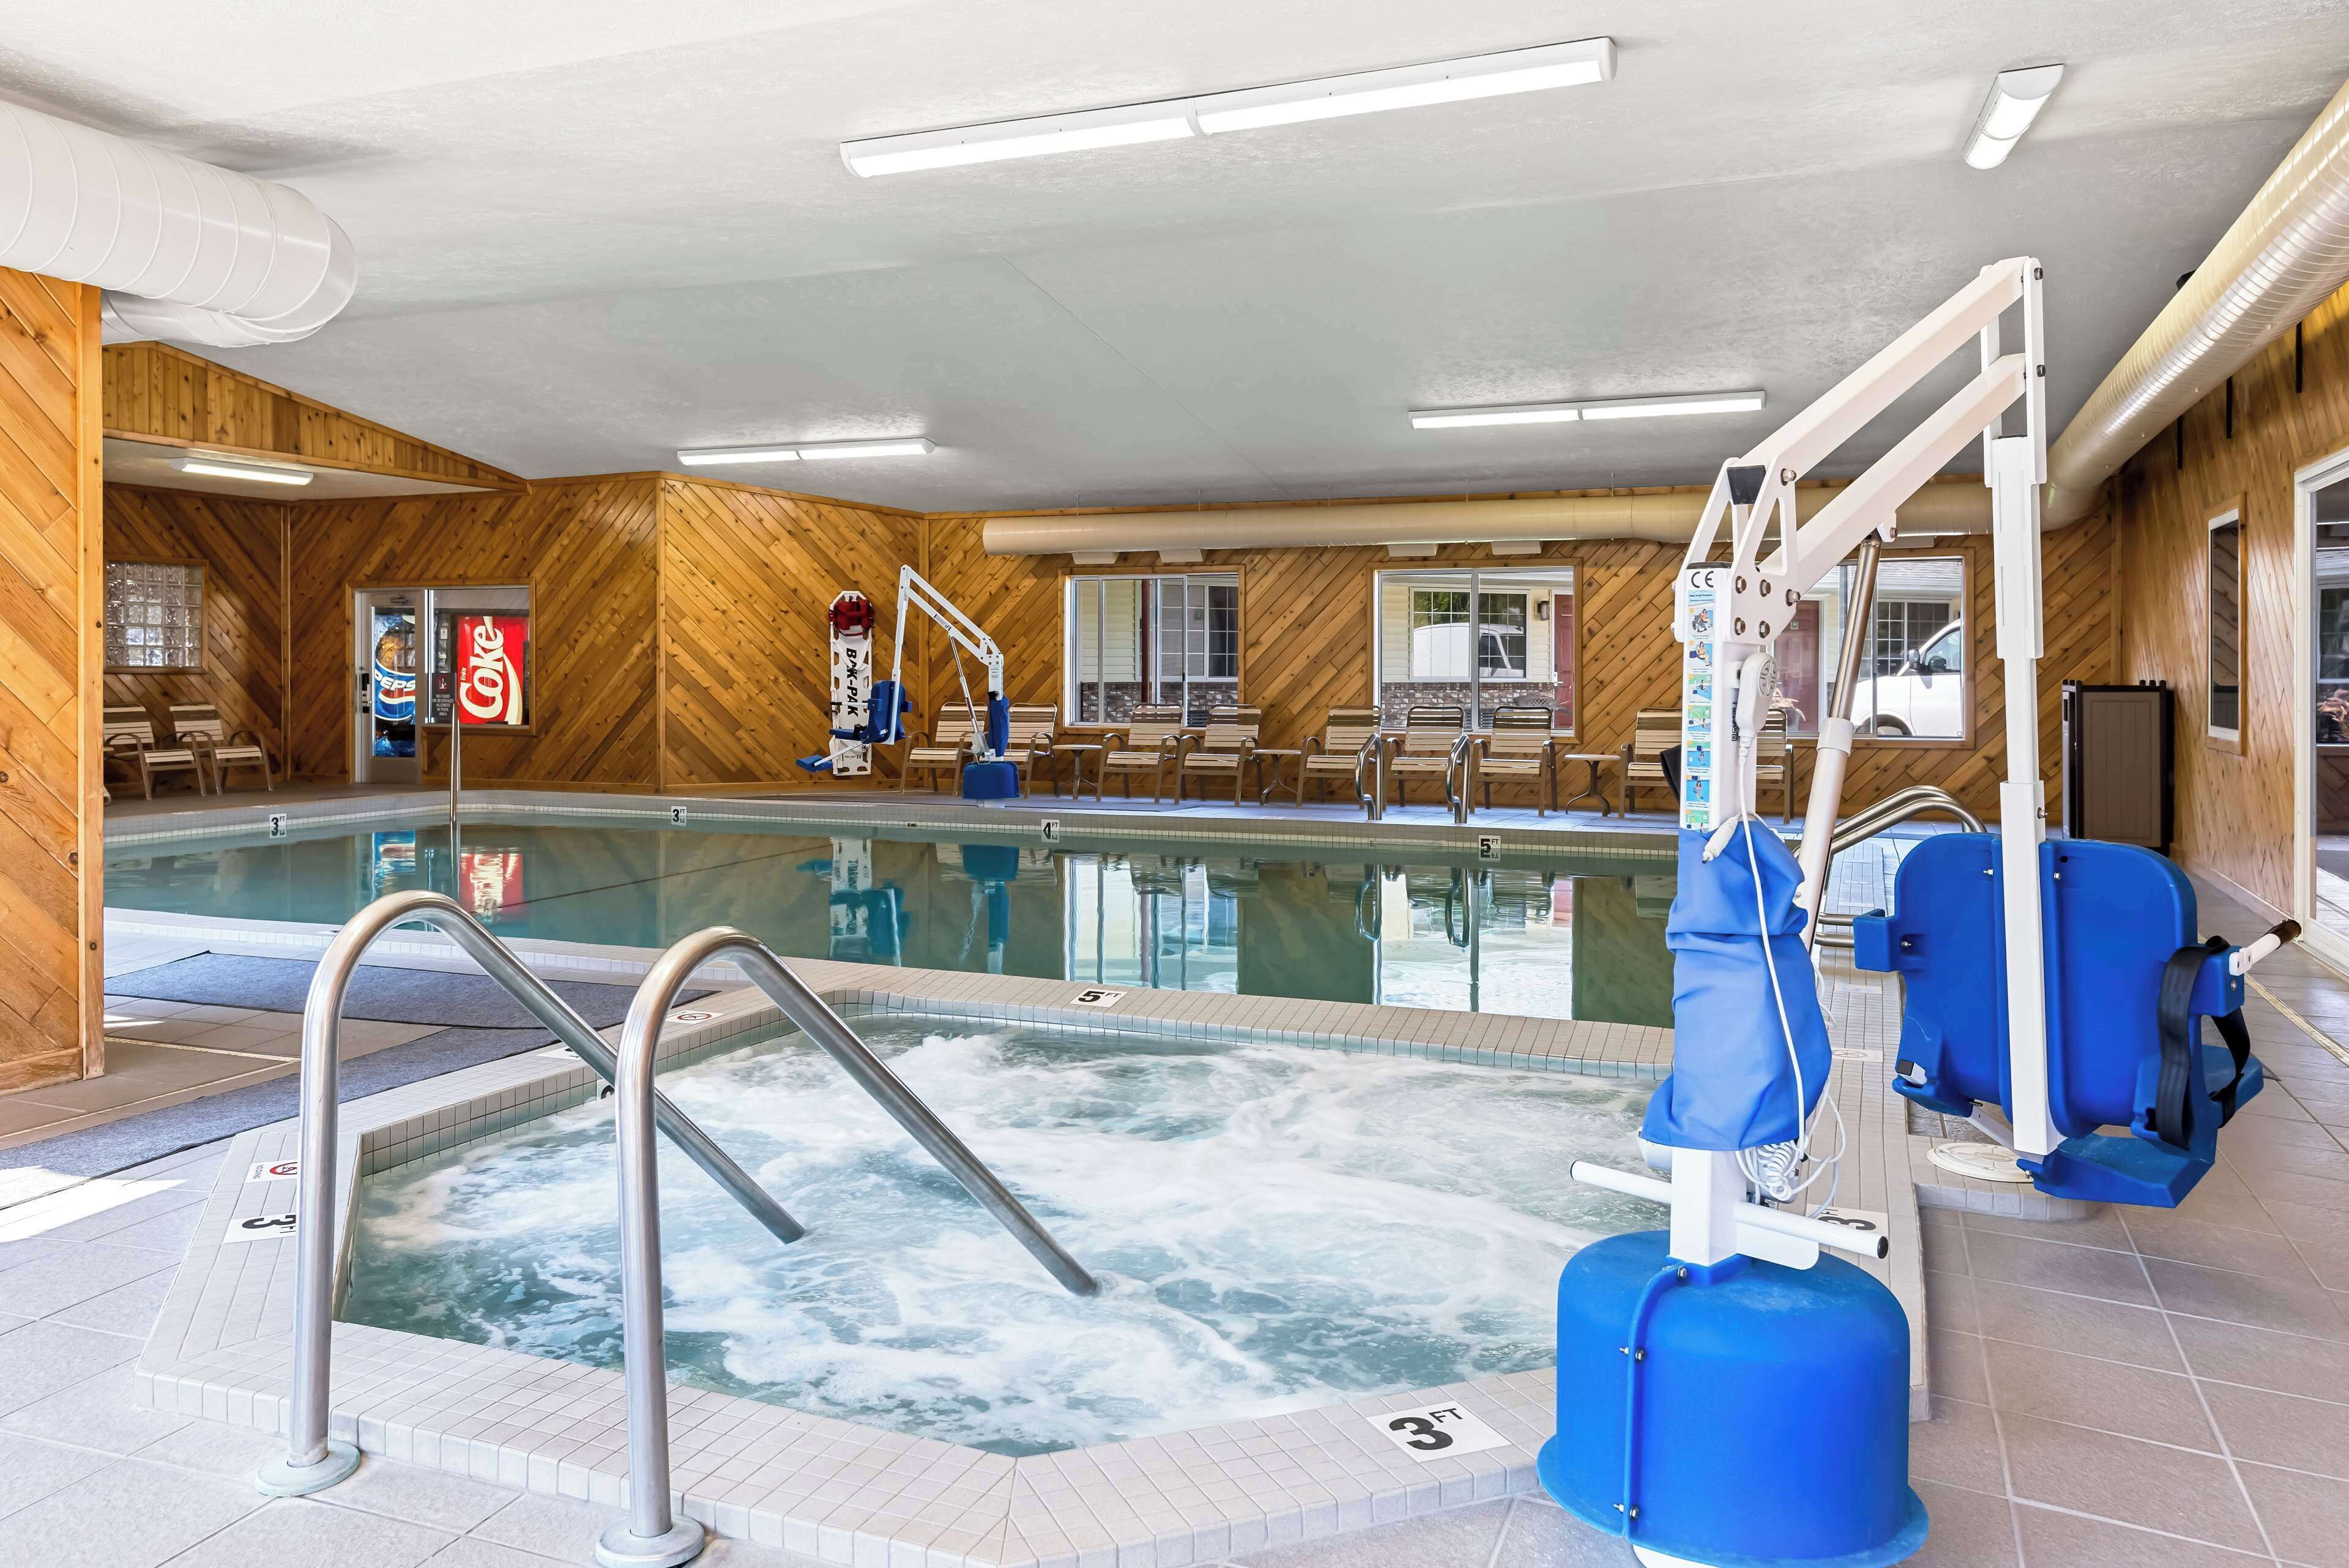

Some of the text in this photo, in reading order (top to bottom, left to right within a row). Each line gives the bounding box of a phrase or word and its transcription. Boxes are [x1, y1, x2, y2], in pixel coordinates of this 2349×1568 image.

[460, 625, 504, 718] Coke
[672, 809, 679, 819] 3
[271, 817, 279, 831] 3
[1481, 839, 1491, 852] 5
[1078, 990, 1106, 1002] 5
[242, 1214, 296, 1229] 3
[1389, 1408, 1462, 1451] 3 FT
